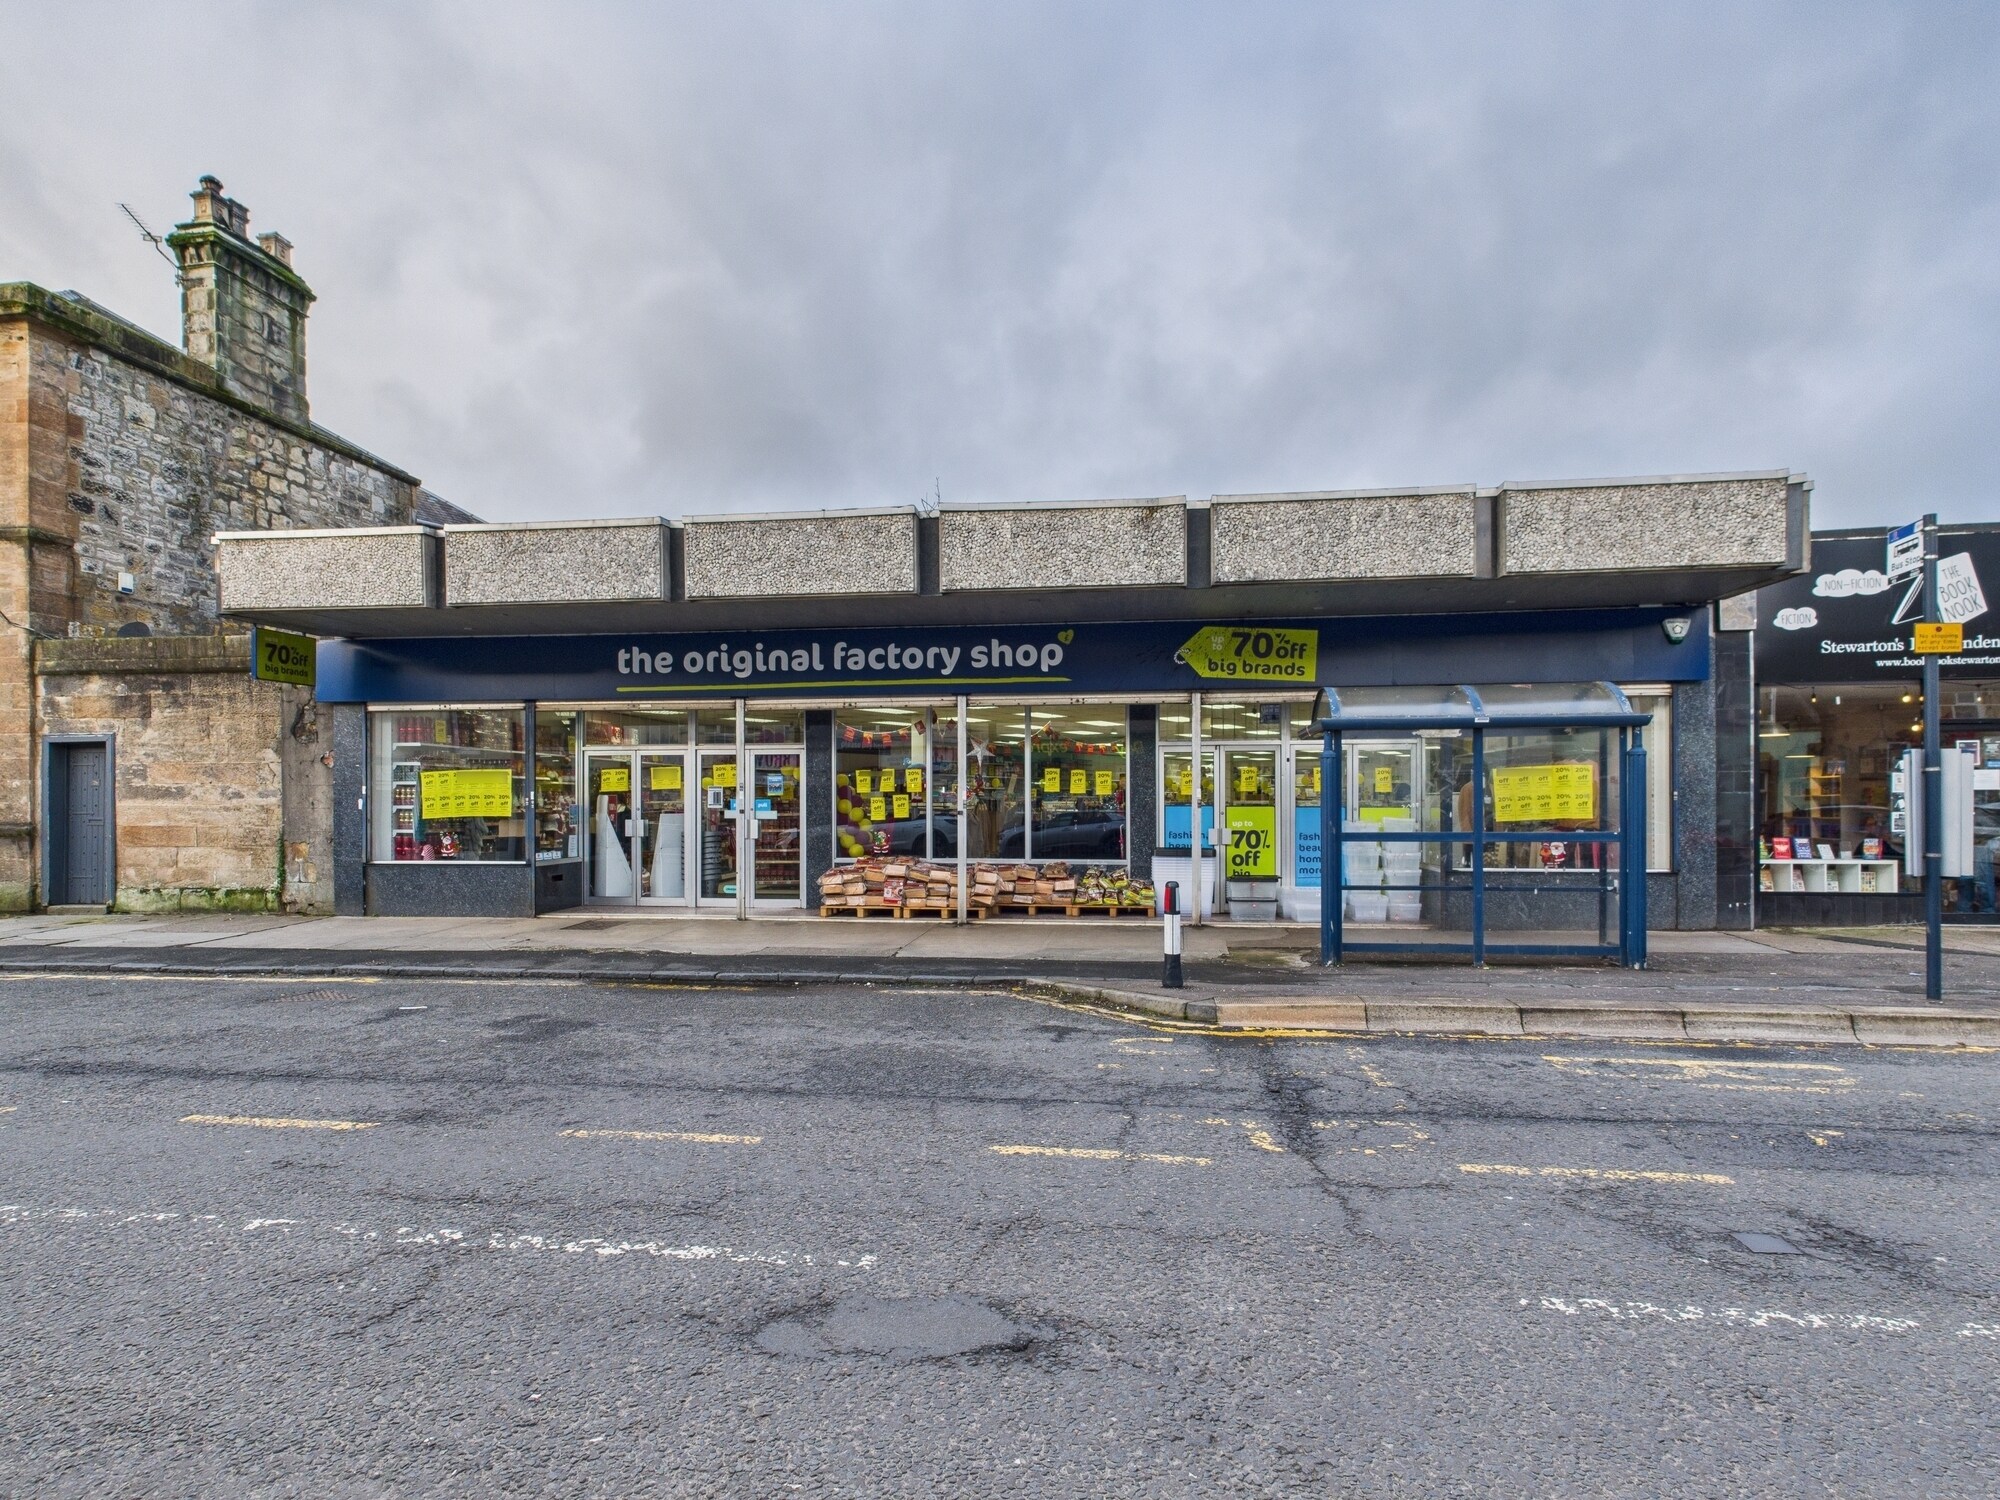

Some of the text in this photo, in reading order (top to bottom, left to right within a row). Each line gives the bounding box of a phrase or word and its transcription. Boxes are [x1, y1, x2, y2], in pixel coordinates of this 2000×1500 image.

[1891, 556, 1921, 571] Bus Stop
[1941, 565, 1961, 579] THE
[1939, 576, 1978, 603] BOOK
[1944, 593, 1983, 622] NOOK
[1781, 613, 1812, 625] FICTION
[1211, 635, 1224, 643] up
[1821, 637, 1904, 654] Stewarton's
[618, 639, 1063, 678] the original factory shop
[1275, 642, 1307, 660] off
[291, 655, 309, 667] off
[1207, 658, 1306, 677] big brands
[265, 664, 309, 677] big brands
[1168, 830, 1208, 840] fashin,
[1231, 829, 1270, 849] 70%
[1298, 832, 1320, 841] fash
[1231, 850, 1261, 867] off
[1298, 855, 1321, 863] hom
